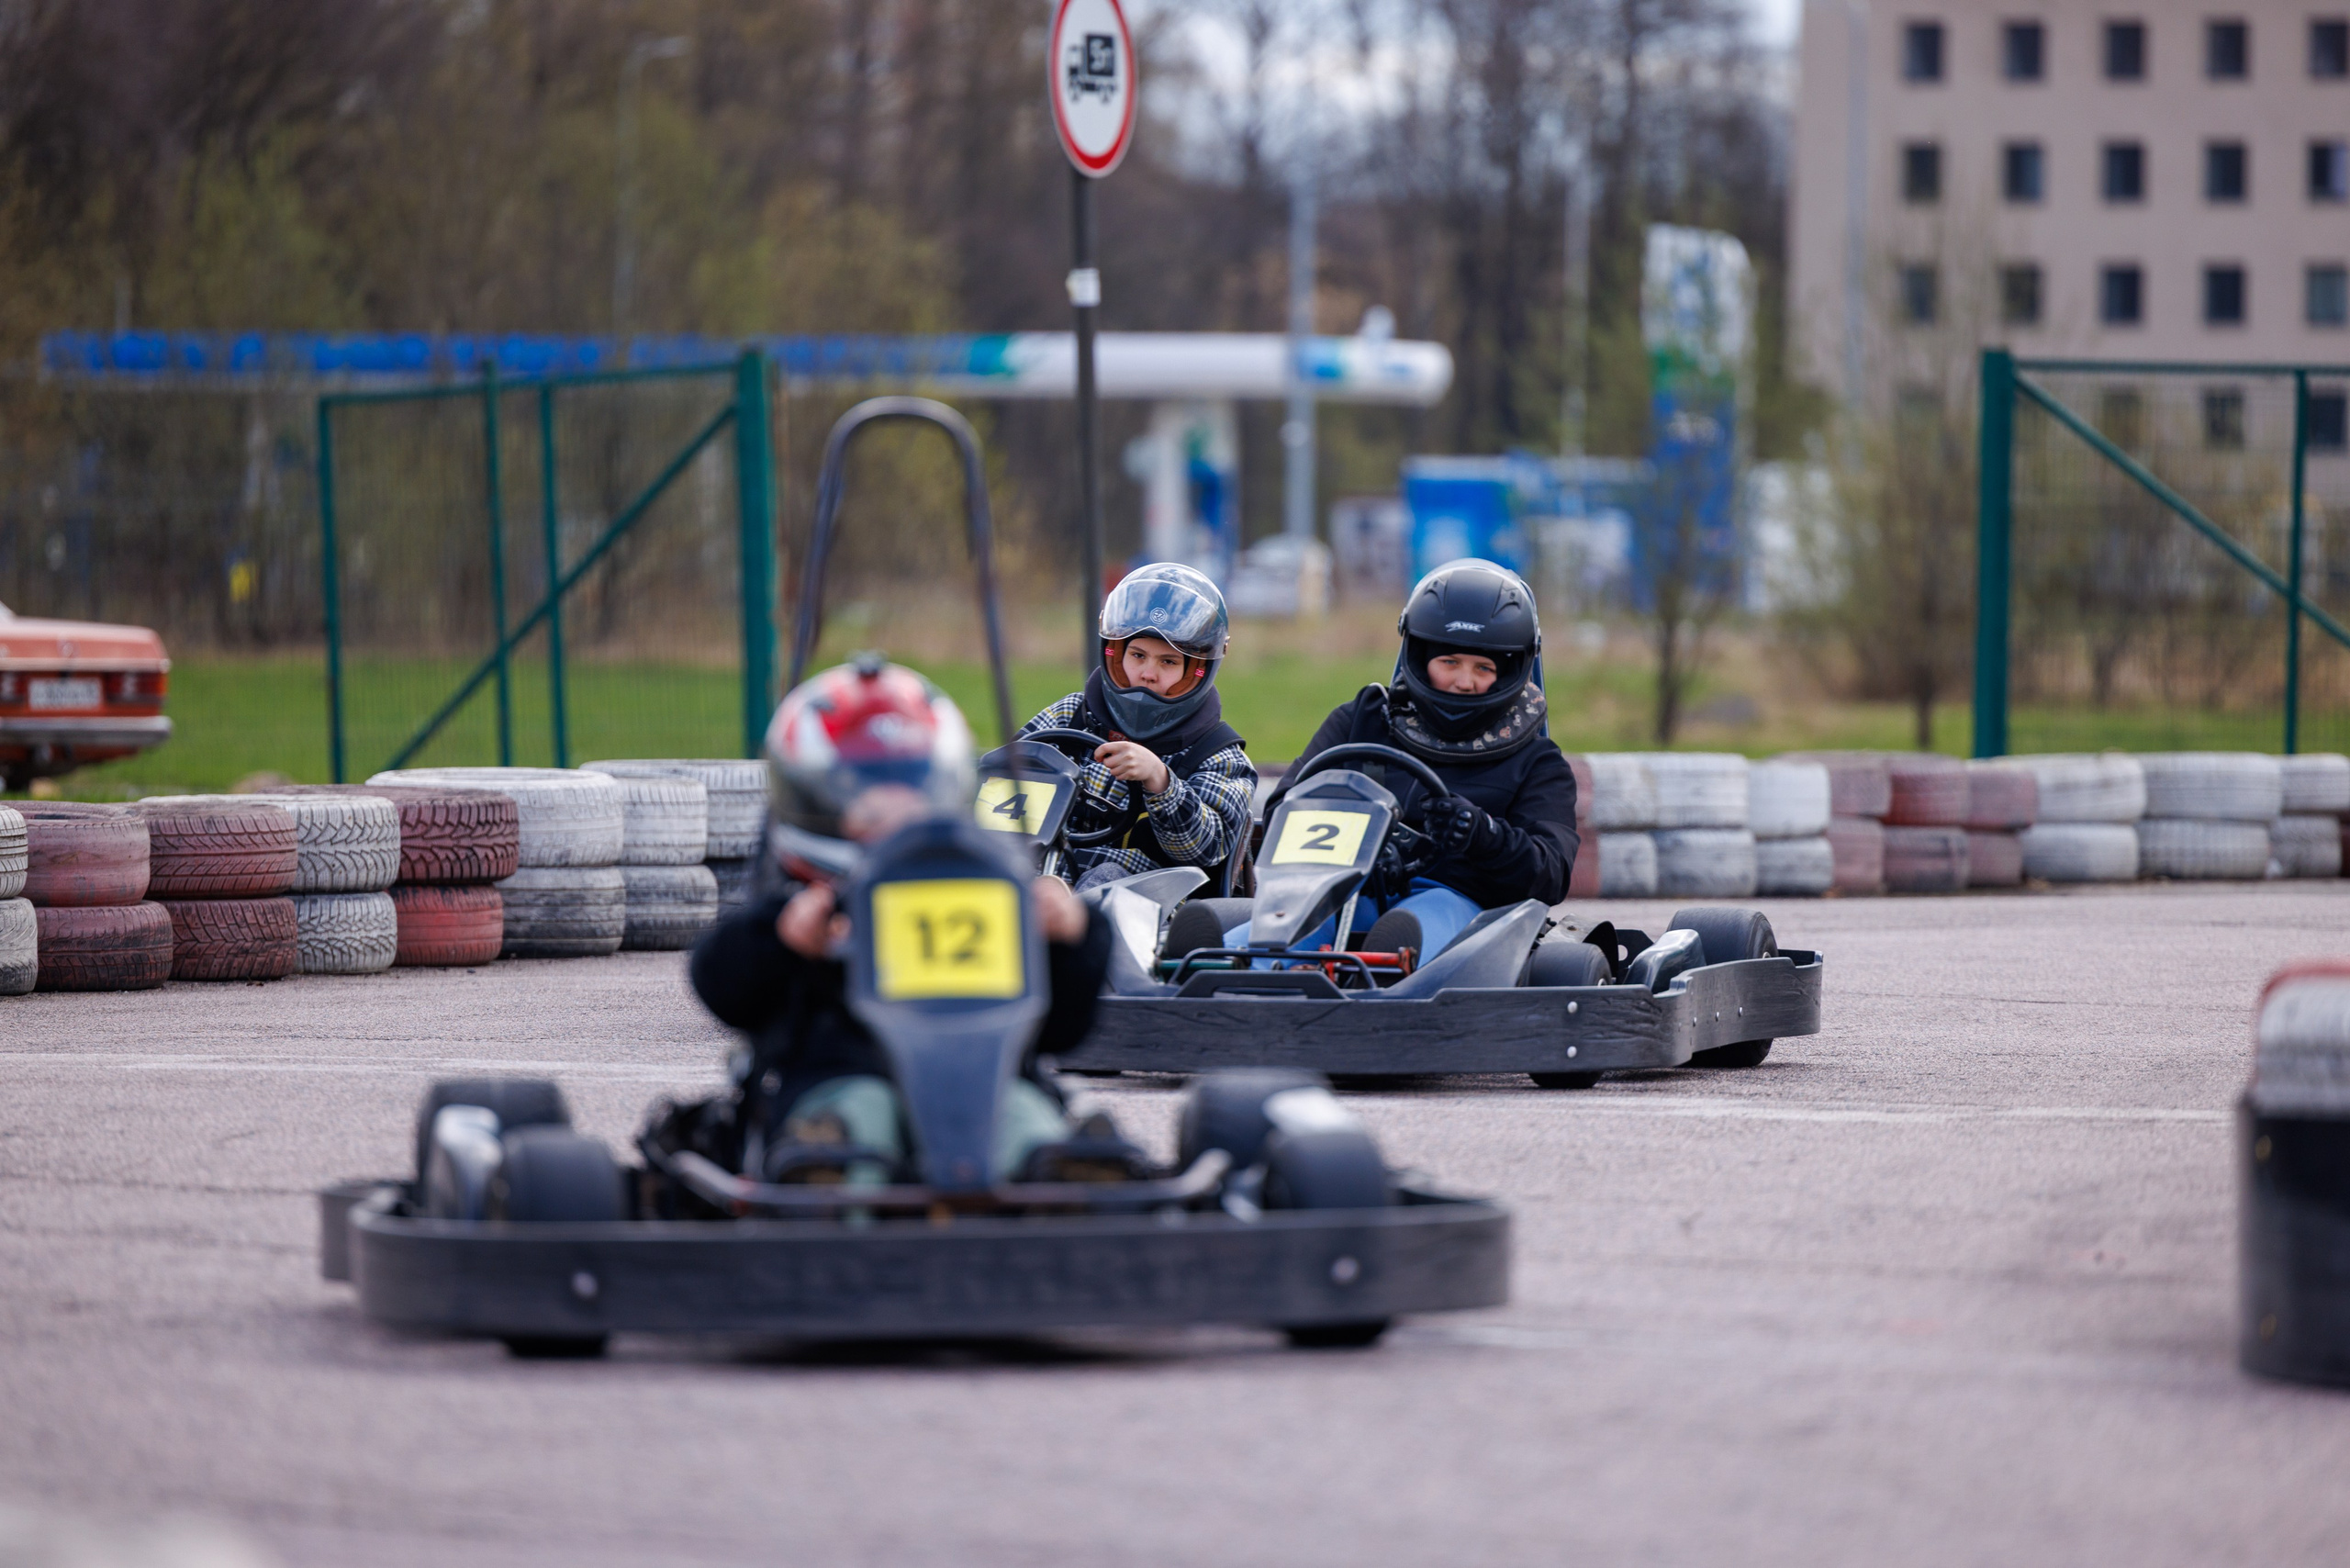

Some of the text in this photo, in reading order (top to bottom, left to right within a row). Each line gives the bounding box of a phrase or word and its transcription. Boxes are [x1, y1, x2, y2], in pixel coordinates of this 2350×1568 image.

[992, 793, 1028, 820] 4
[1300, 823, 1340, 851] 2
[913, 910, 989, 963] 12
